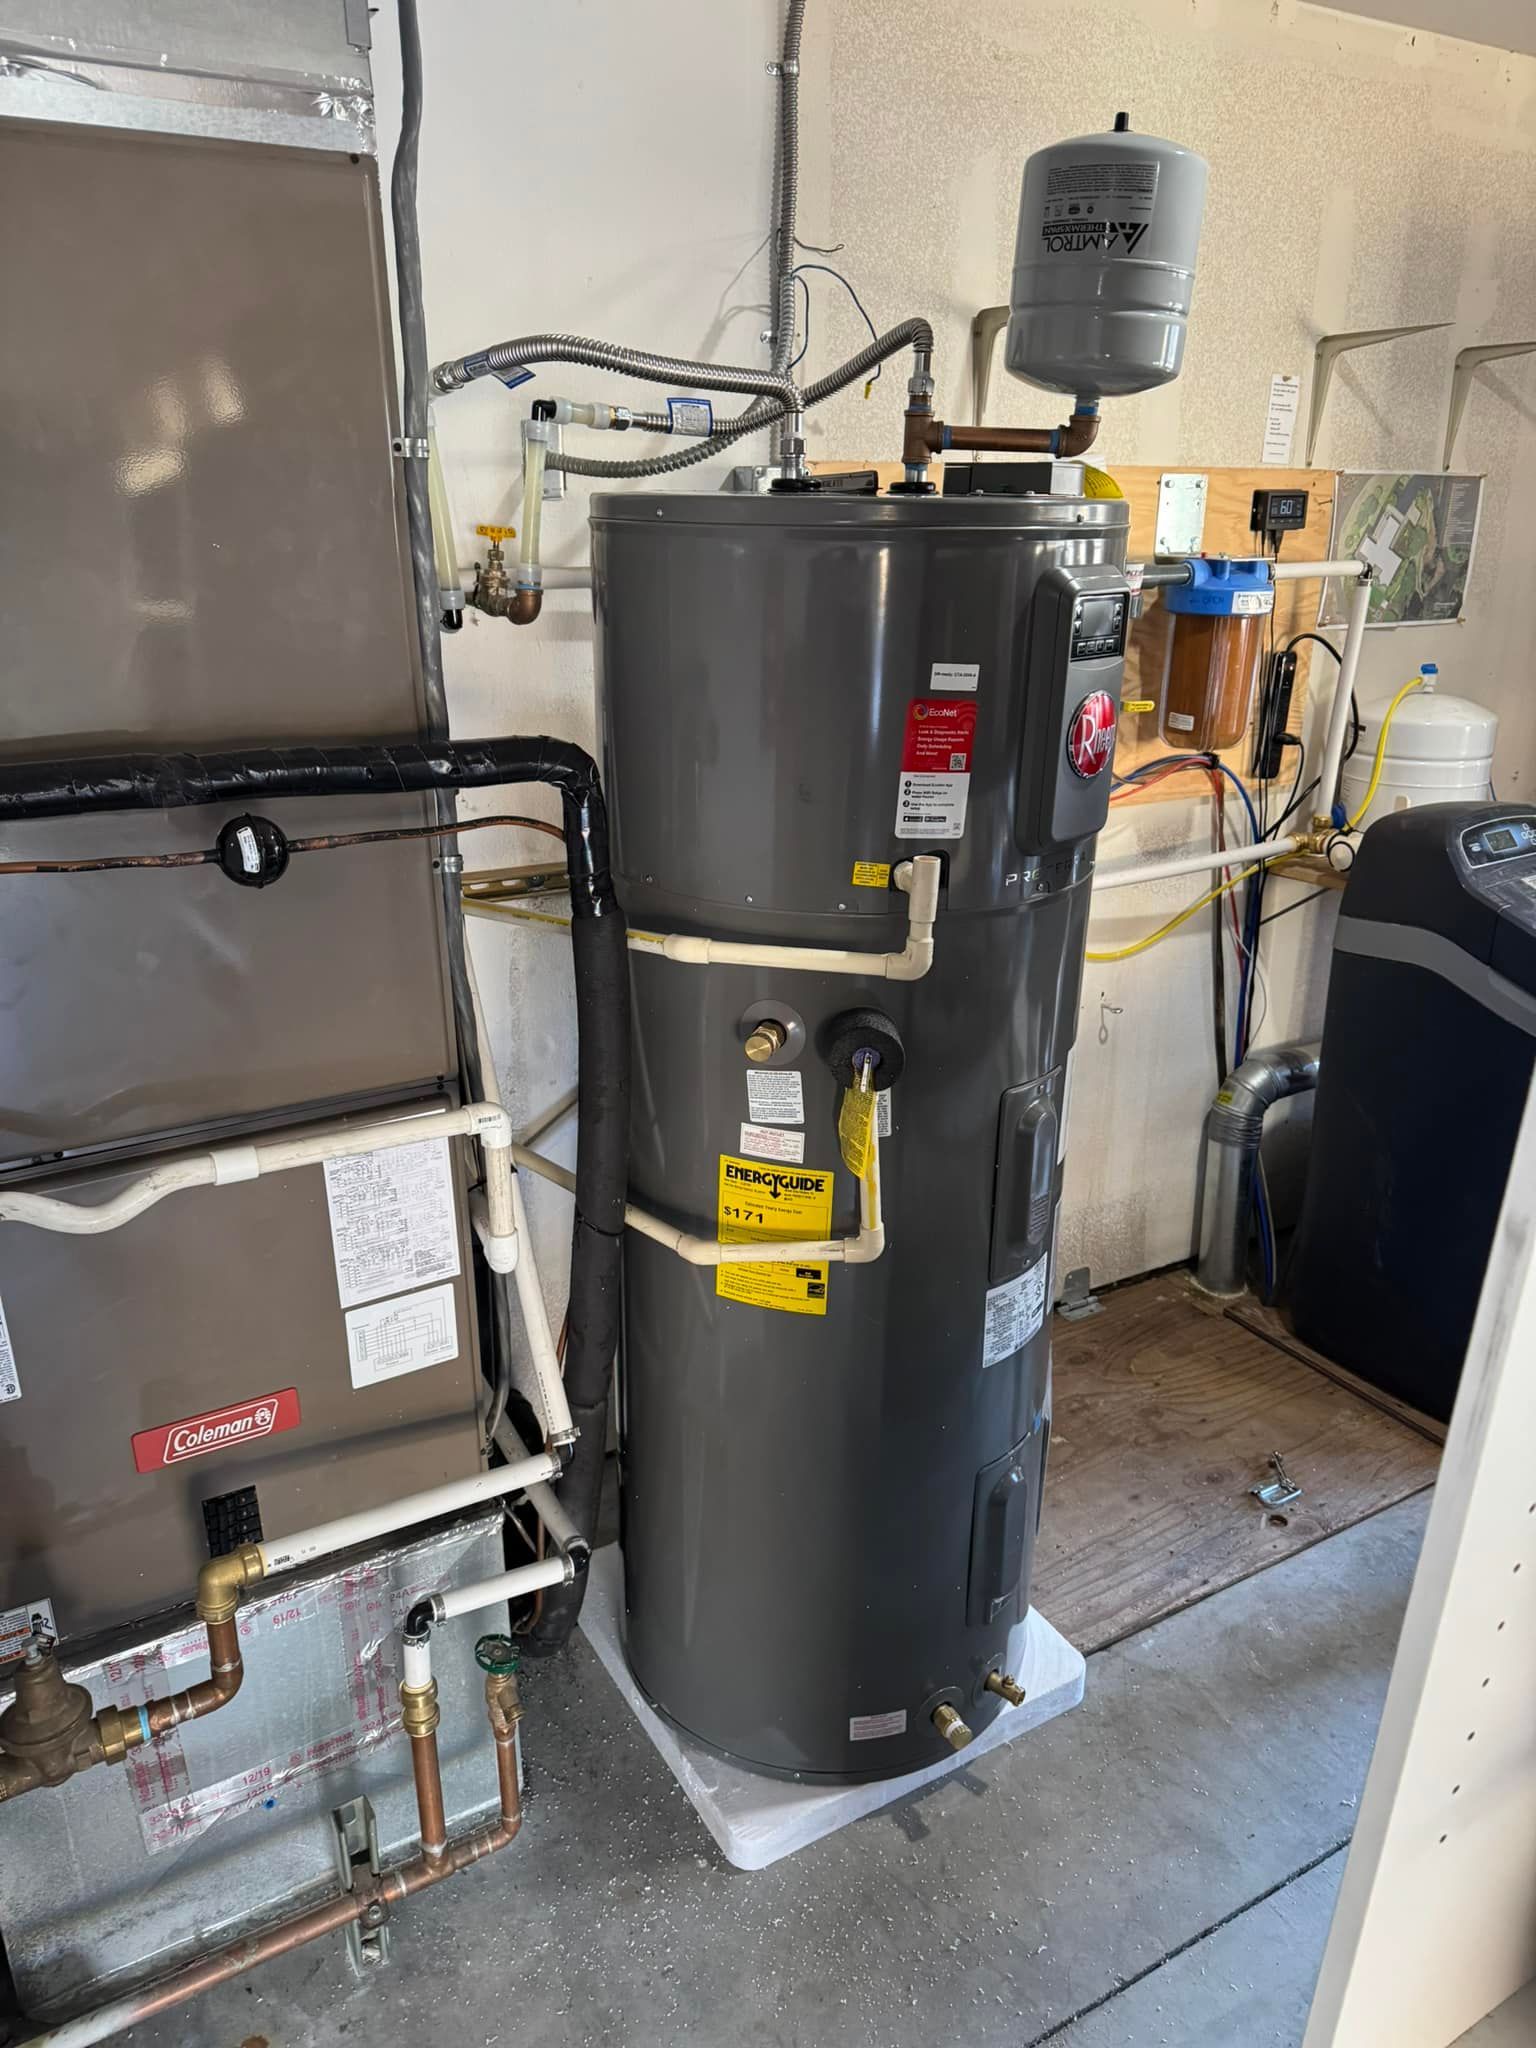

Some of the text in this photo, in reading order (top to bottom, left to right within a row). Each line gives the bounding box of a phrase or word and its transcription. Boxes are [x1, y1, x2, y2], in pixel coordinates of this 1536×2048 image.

[1042, 233, 1119, 253] AMTROL
[1279, 499, 1293, 515] 60
[928, 708, 957, 718] EcoNet
[726, 1164, 825, 1192] ENERGYGUIDE
[723, 1205, 765, 1224] $171
[173, 1415, 253, 1452] Coleman
[241, 1766, 271, 1786] 12/19
